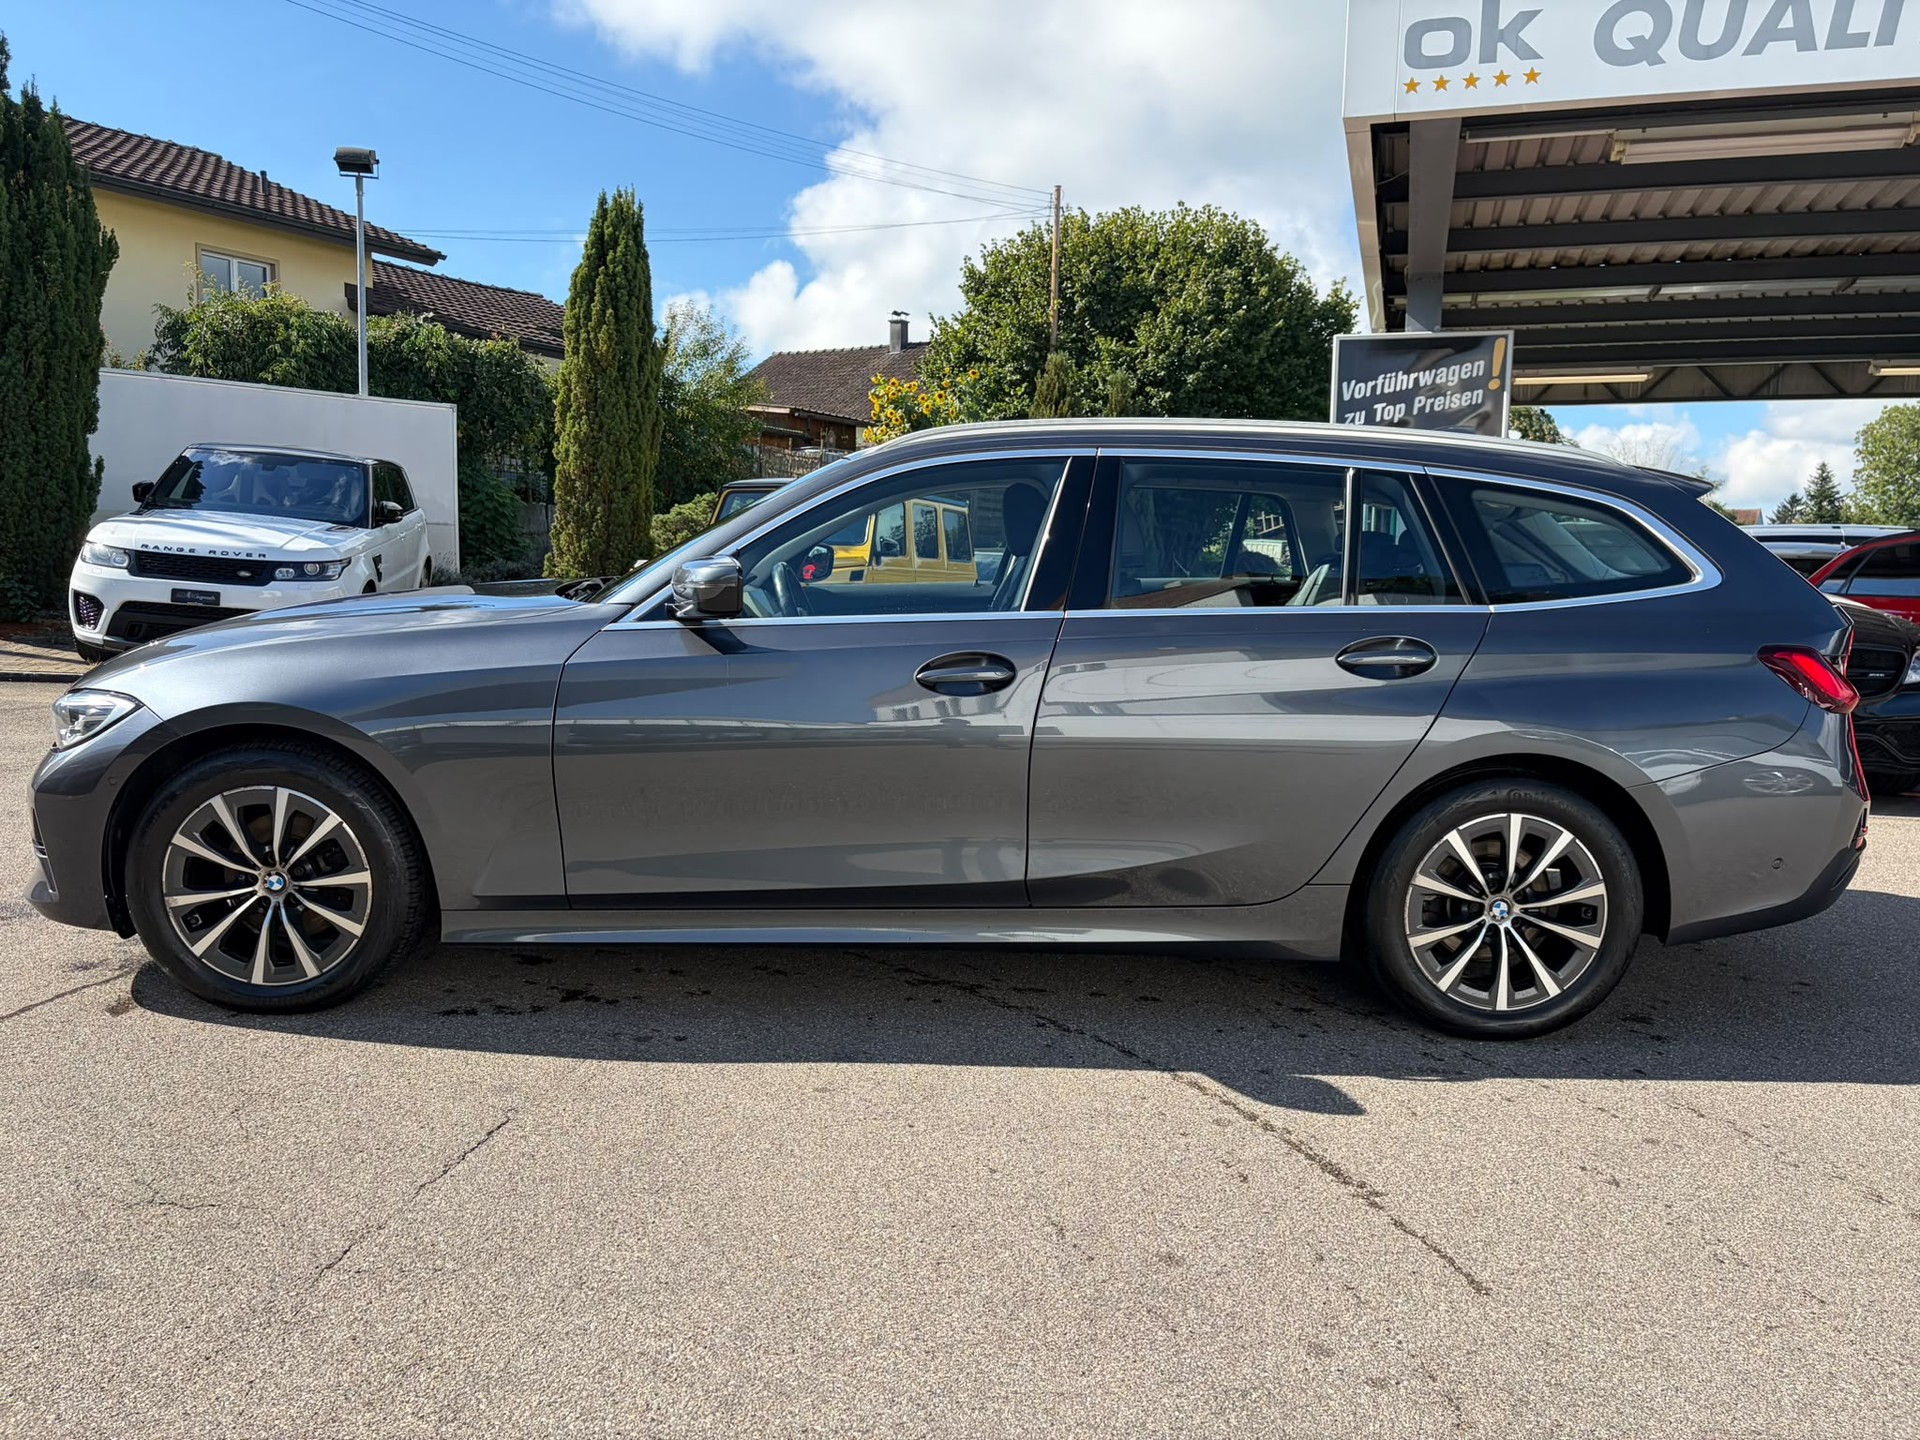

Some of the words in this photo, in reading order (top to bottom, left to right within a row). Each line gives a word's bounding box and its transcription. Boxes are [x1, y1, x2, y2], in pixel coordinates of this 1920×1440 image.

[1404, 0, 1544, 69] ok
[1342, 359, 1485, 401] Vorführwagen
[1344, 409, 1366, 426] zu
[1373, 402, 1406, 424] Top
[1412, 389, 1484, 416] Preisen
[140, 544, 196, 554] RANGE
[208, 549, 267, 558] ROVER
